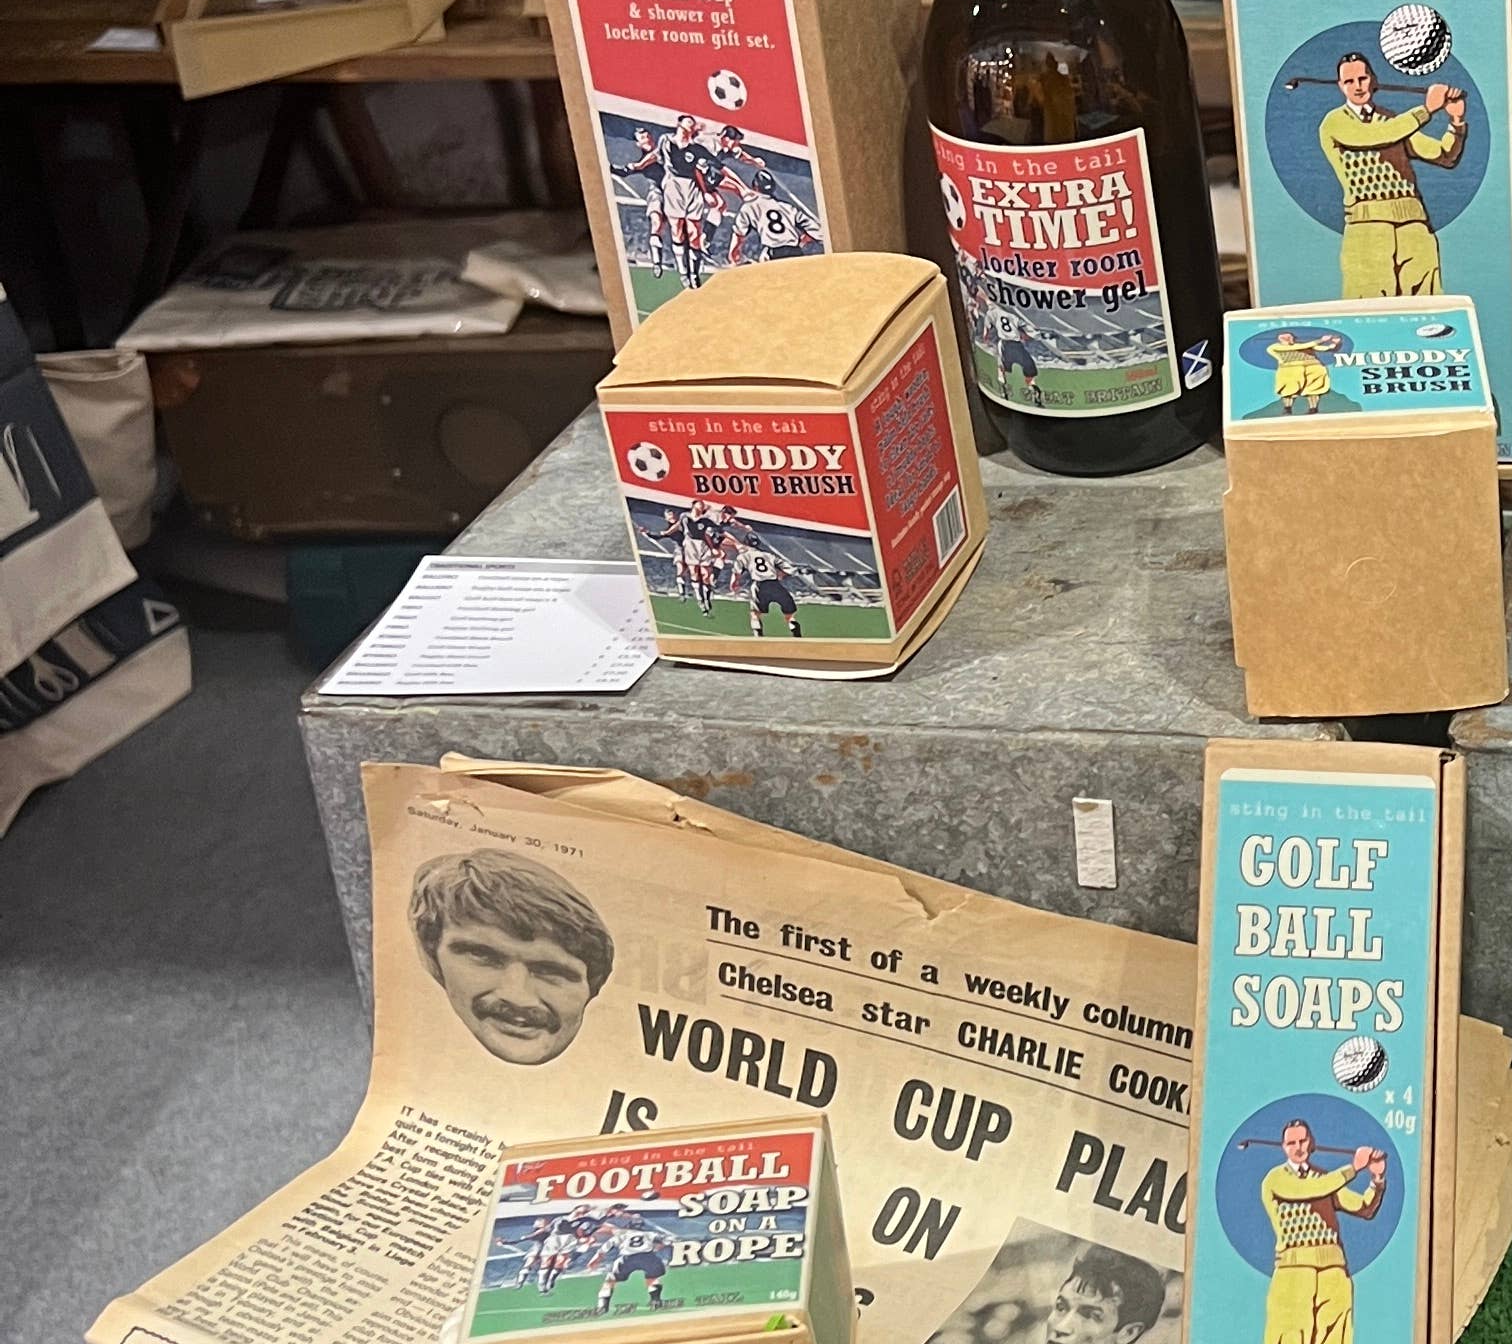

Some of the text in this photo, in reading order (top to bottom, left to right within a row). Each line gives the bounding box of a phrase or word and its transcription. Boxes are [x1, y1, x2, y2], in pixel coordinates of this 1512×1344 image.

[630, 4, 735, 26] & shower gel
[605, 25, 775, 50] locker room gift set.
[968, 171, 1132, 208] EXTRA
[768, 209, 784, 234] 8
[973, 198, 1139, 250] TIME!
[981, 247, 1141, 280] locker room
[987, 270, 1149, 313] shower gel
[1334, 348, 1472, 368] MUDDY
[1361, 365, 1471, 380] SHOE
[1363, 380, 1473, 395] BRUSH
[688, 444, 846, 471] MUDDY
[693, 475, 856, 496] BOOT BRUSH
[754, 557, 768, 573] 8
[408, 806, 583, 857] Saturday, January 30, 1971
[1240, 833, 1389, 891] GOLF
[1234, 904, 1383, 961] BALL
[705, 905, 1193, 1050] The first of a weekly column
[1231, 974, 1404, 1034] SOAPS
[717, 962, 1191, 1115] Chelsea star CHARLIE COOK
[637, 1003, 838, 1109] WORLD
[893, 1078, 1014, 1161] CUP
[1384, 1087, 1414, 1104] x 4
[401, 1105, 492, 1146] IT has certainly
[1384, 1109, 1417, 1133] 40g
[388, 1130, 486, 1172] After recapturing
[395, 1120, 496, 1160] quite for
[532, 1152, 791, 1205] FOOTBALL
[678, 1185, 808, 1218] SOAP
[708, 1215, 778, 1234] ON A
[872, 1186, 961, 1261] ON
[668, 1234, 804, 1268] ROPE
